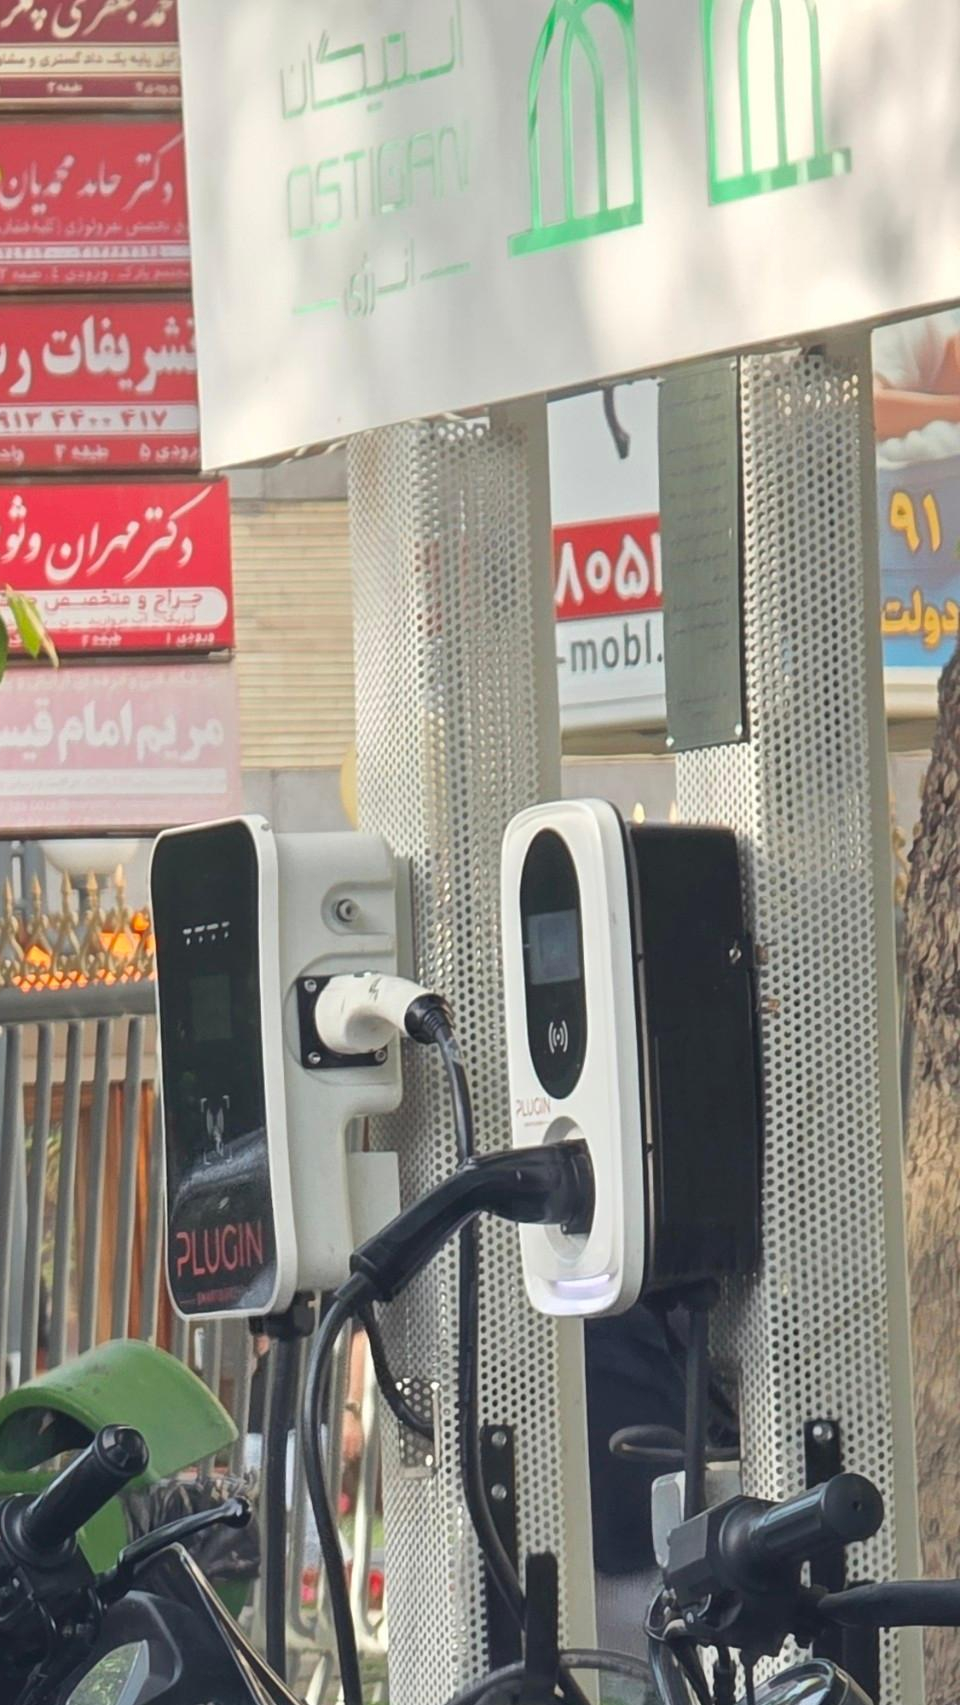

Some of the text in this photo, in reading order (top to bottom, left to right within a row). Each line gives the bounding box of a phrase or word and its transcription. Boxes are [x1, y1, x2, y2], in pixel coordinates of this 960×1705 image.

[76, 159, 123, 199] حامد
[121, 130, 185, 213] دکتر
[287, 119, 470, 239] OSTIGAN
[155, 443, 199, 463] رودی
[44, 520, 140, 585] مهران
[122, 485, 213, 584] دکتر
[44, 589, 130, 612] متخصص
[153, 589, 204, 613] جراح
[57, 699, 133, 764] امام
[137, 706, 225, 762] مریم
[175, 1219, 264, 1278] PLUGIN
